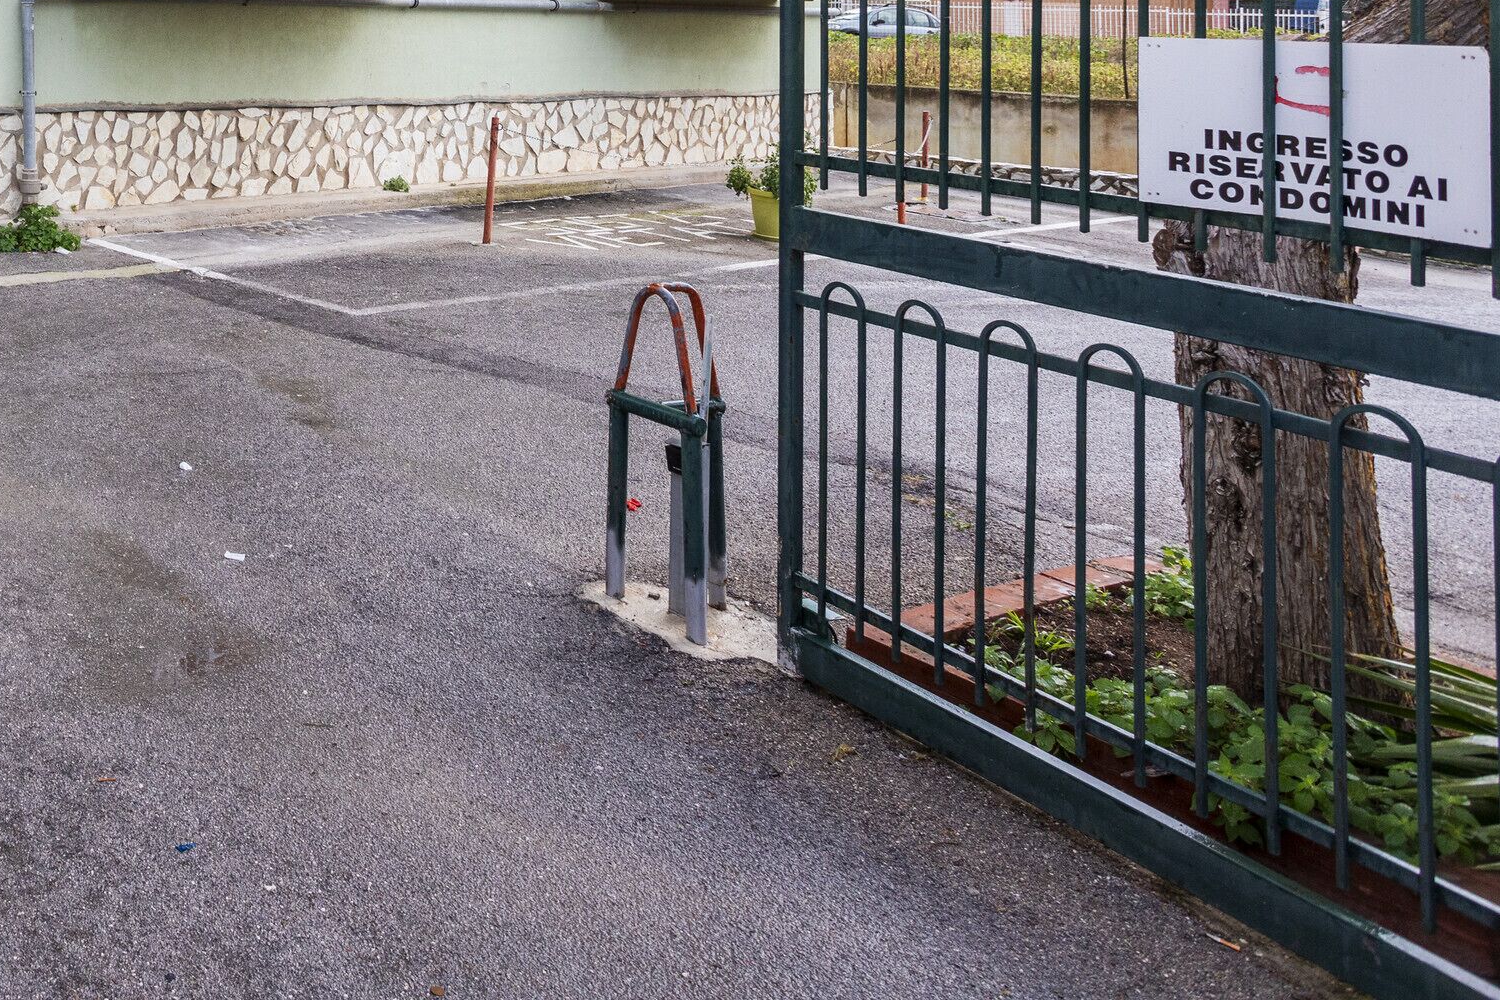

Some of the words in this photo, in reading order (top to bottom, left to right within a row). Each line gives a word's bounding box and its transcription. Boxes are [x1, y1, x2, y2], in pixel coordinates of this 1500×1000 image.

[1189, 178, 1426, 228] CONDOMINI
[1407, 175, 1448, 202] AI
[525, 219, 754, 251] VIETAT
